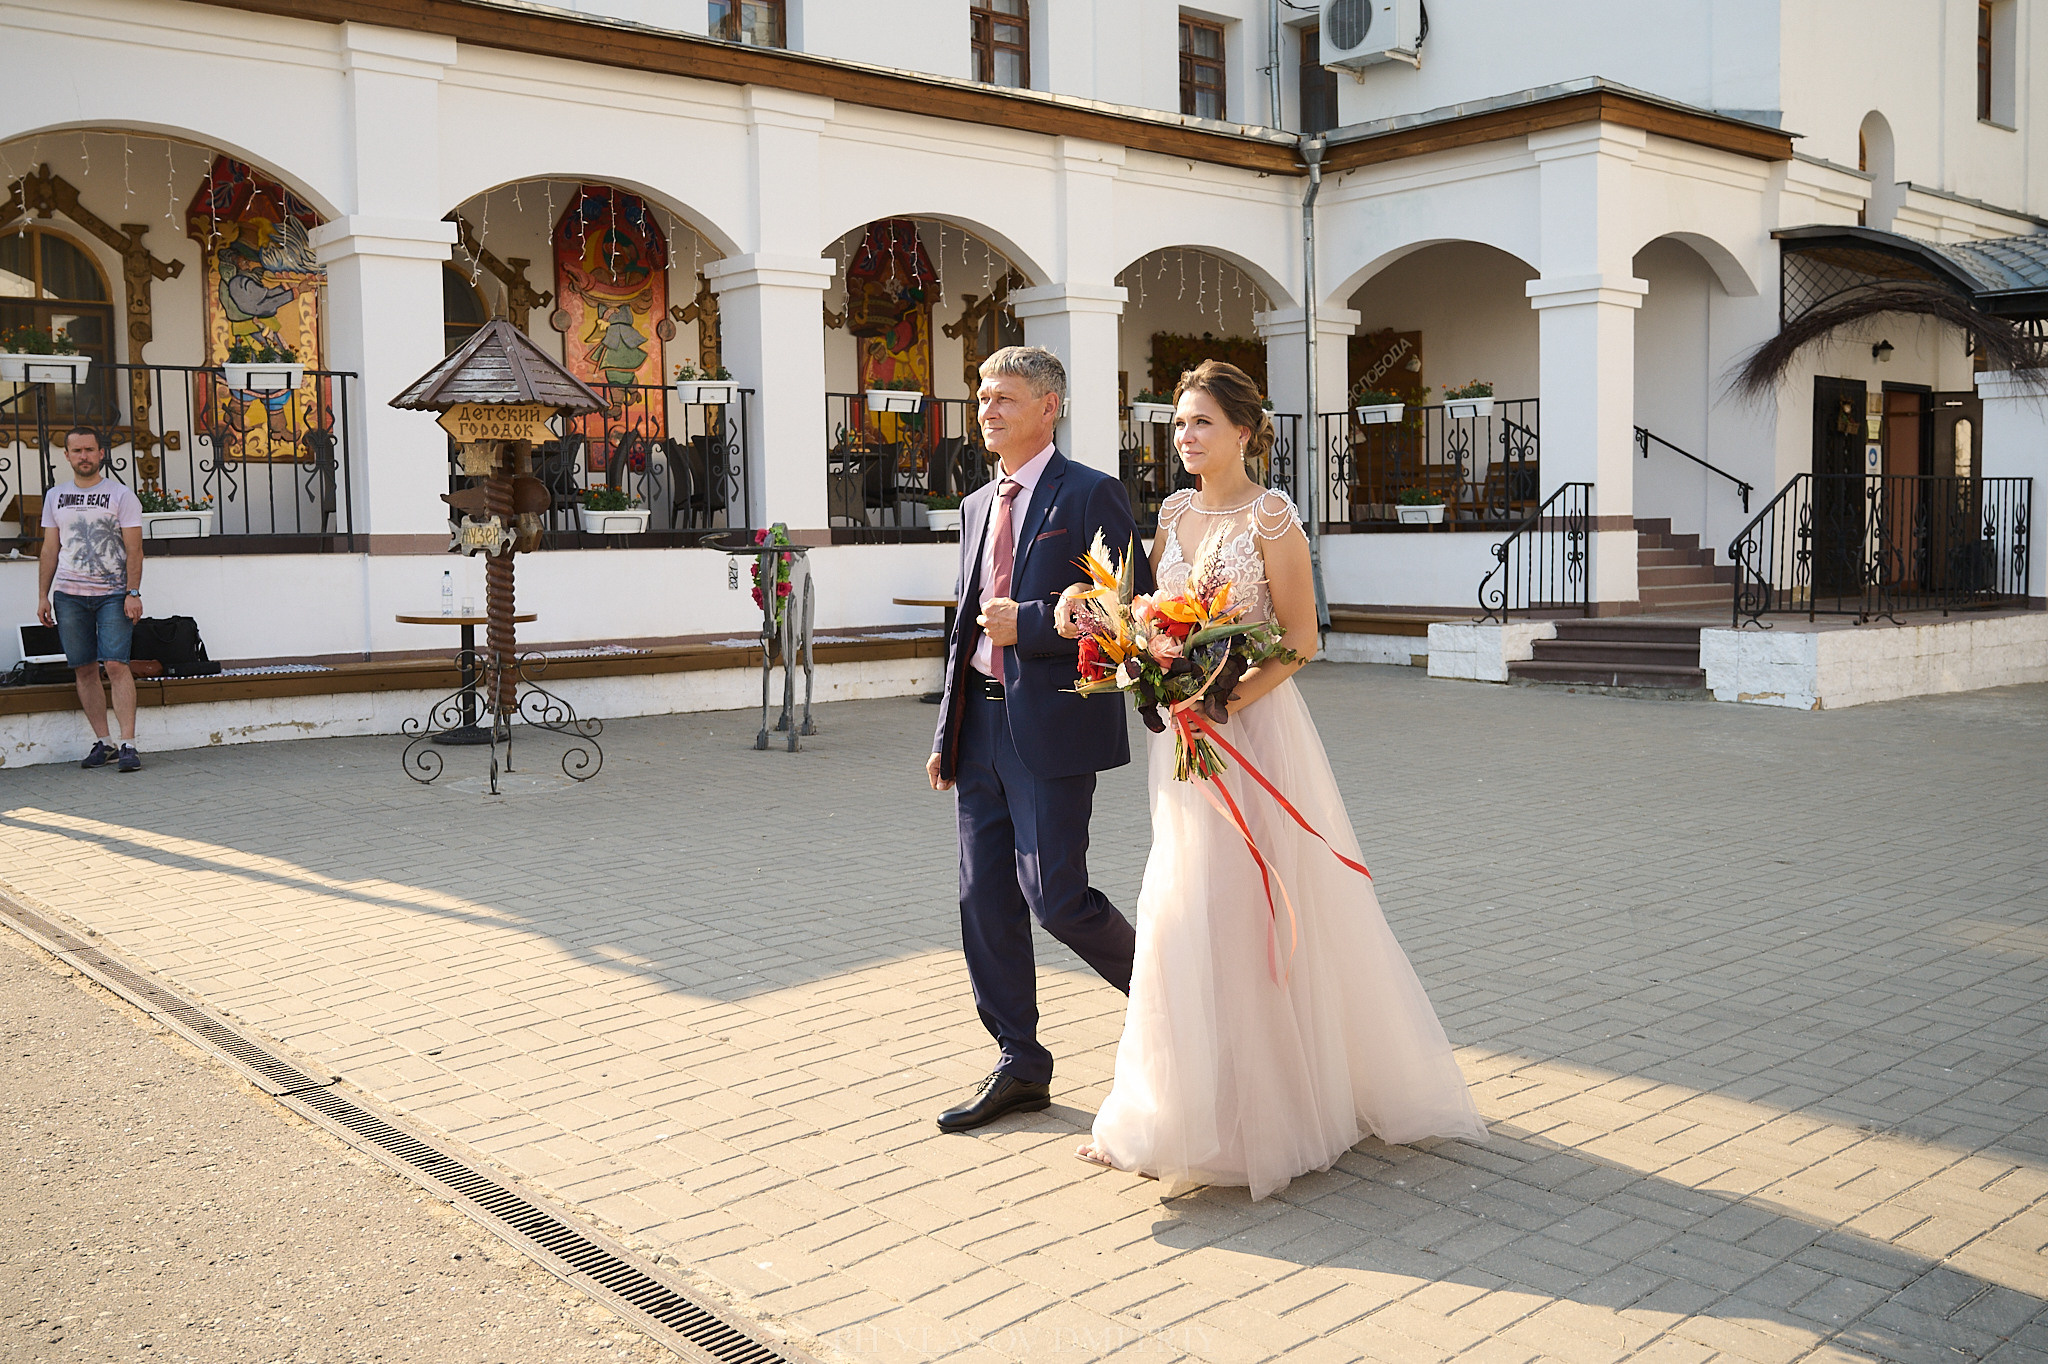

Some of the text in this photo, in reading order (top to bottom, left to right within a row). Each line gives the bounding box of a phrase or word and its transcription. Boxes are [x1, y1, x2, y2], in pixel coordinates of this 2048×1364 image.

[459, 422, 534, 438] ГОРОДОК
[57, 493, 111, 509] SUMMER BEACH
[729, 566, 738, 590] 2021
